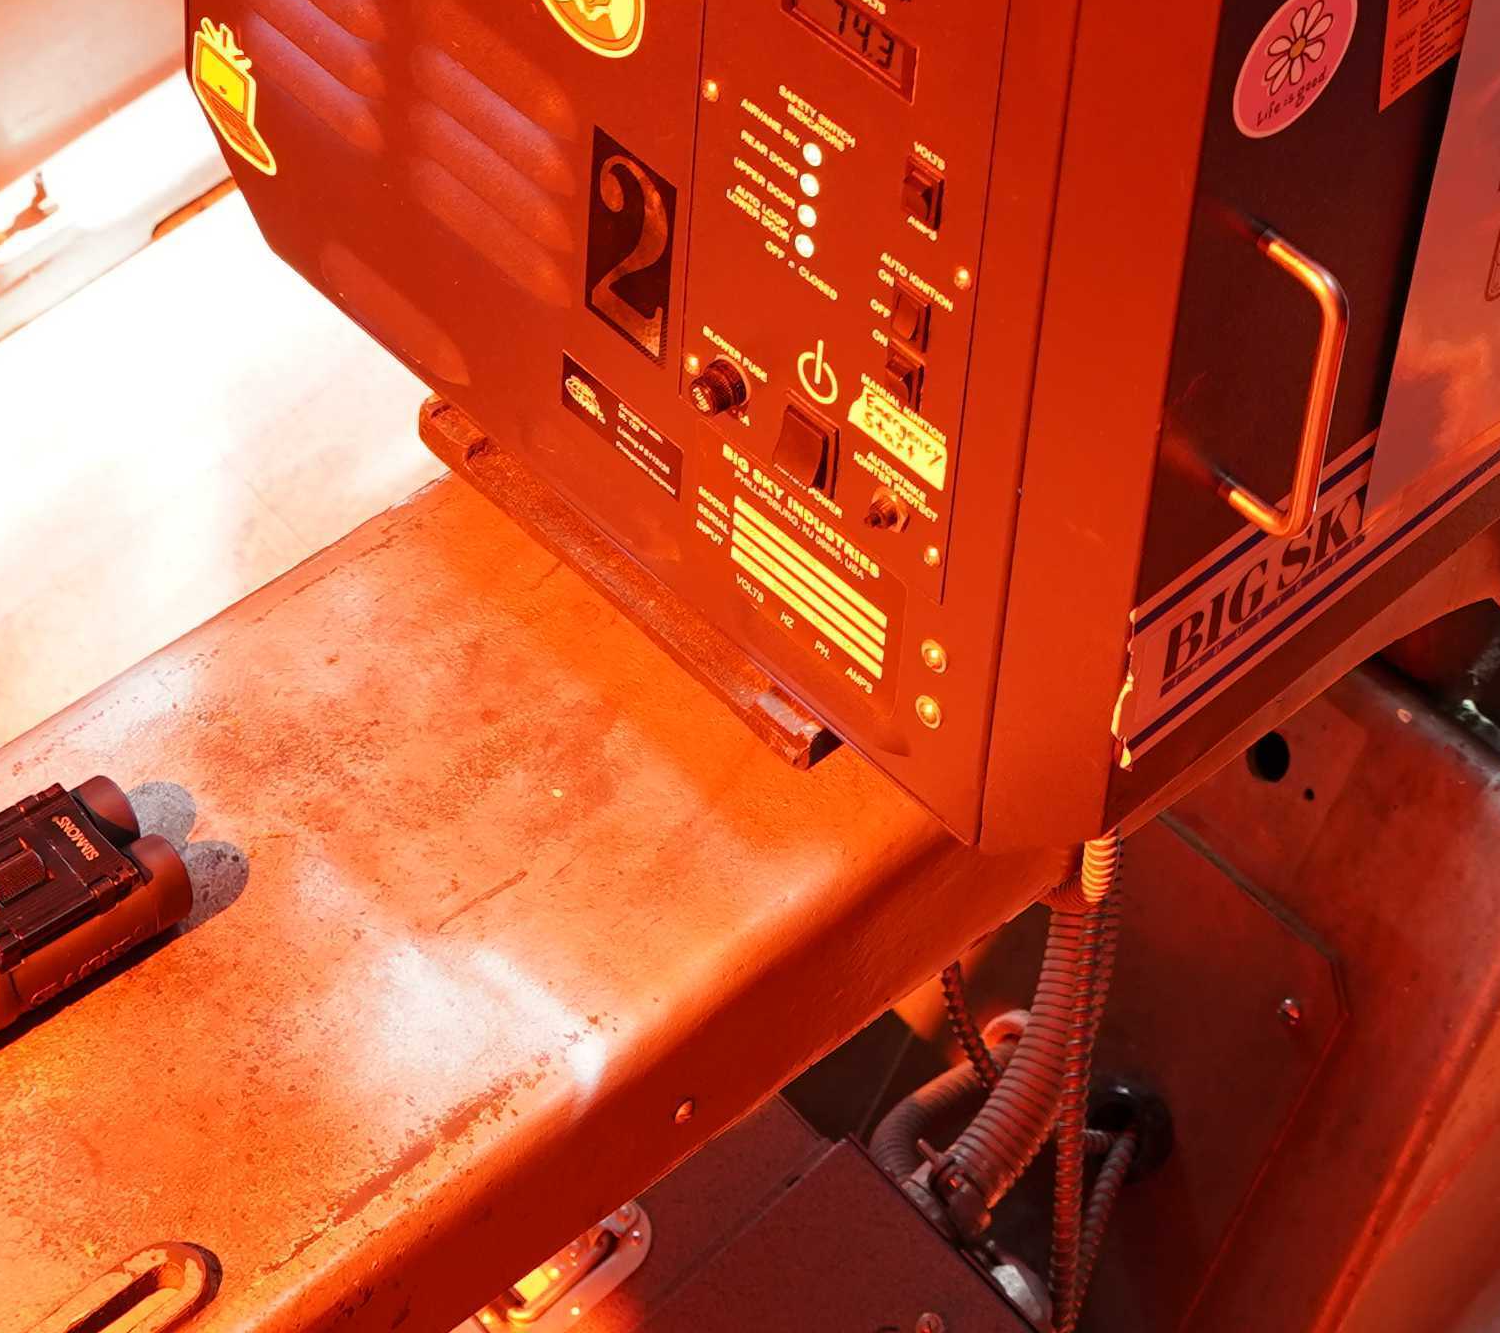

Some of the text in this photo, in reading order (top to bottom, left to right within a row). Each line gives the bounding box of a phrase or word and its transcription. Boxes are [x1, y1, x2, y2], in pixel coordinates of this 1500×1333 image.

[777, 84, 857, 149] SAFETY SWITCH
[1256, 65, 1329, 128] Life is good
[786, 103, 846, 152] INDICATORS
[739, 129, 799, 180] REAR DOOR
[913, 141, 946, 172] VOLTS
[733, 156, 796, 210] UPPER DOOR
[734, 184, 789, 228] AUTO LOOP
[725, 187, 791, 244] LOWER DOOR
[906, 215, 938, 242] AMPS
[591, 154, 669, 359] 2
[764, 239, 839, 302] OFF CLOSED
[877, 268, 896, 288] ON
[879, 251, 954, 313] AUTO IGNITION
[869, 297, 892, 319] OFF
[702, 324, 769, 384] BLOWER FUSE
[871, 328, 889, 348] ON
[691, 385, 712, 414] FUSE
[859, 371, 948, 447] MANUAL IGNITION
[863, 411, 916, 461] Start
[865, 391, 944, 468] Emergency
[697, 485, 731, 518] MODEL
[807, 485, 844, 520] POWER
[852, 450, 893, 489] IGNITER
[892, 481, 940, 524] PROTECT
[865, 450, 928, 504] AUTOSTRIKE
[695, 518, 725, 547] INPUT
[696, 502, 730, 536] SERIAL
[721, 442, 750, 474] BIG
[751, 467, 785, 501] SKY
[787, 495, 881, 580] INDUSTRIES
[734, 572, 874, 695] VOLTS HZ PH. AMPS
[1161, 557, 1270, 682] BIG
[56, 815, 101, 862] SIMMONS
